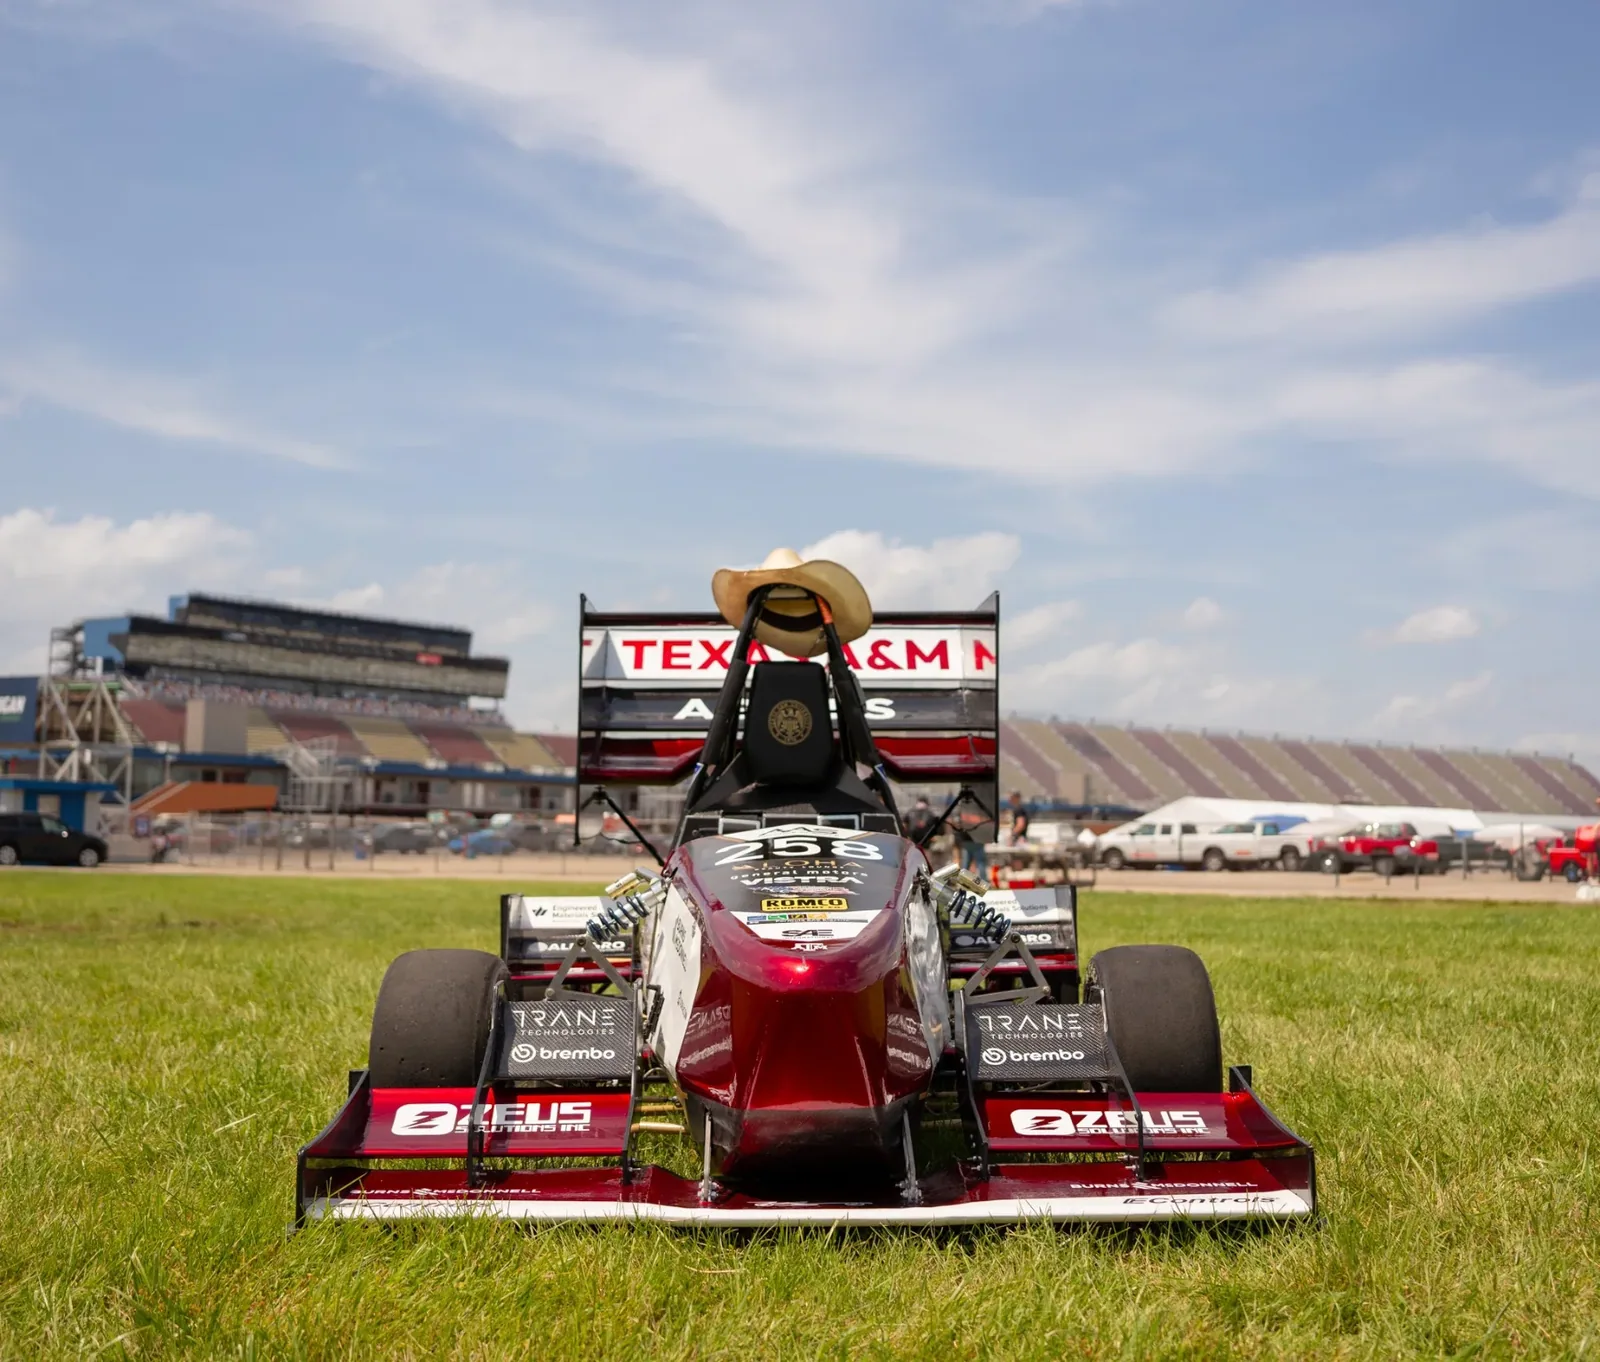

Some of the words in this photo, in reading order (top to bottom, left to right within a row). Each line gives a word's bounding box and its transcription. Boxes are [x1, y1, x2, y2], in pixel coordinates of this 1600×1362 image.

[622, 638, 810, 670] TEXA
[714, 837, 884, 867] 258
[730, 871, 798, 881] general
[806, 869, 869, 878] motors
[740, 876, 865, 886] VISTRA
[766, 898, 844, 907] ROMCO
[513, 1009, 616, 1028] TRANE
[979, 1013, 1082, 1031] TRANE
[521, 1028, 615, 1037] TECHNOLOGIES
[991, 1032, 1083, 1041] TECHNOLOGIES
[540, 1047, 616, 1060] brembo
[1009, 1049, 1084, 1062] brembo
[457, 1102, 592, 1125] ZEUS
[1071, 1110, 1206, 1128] ZEUS
[560, 1124, 590, 1132] INC
